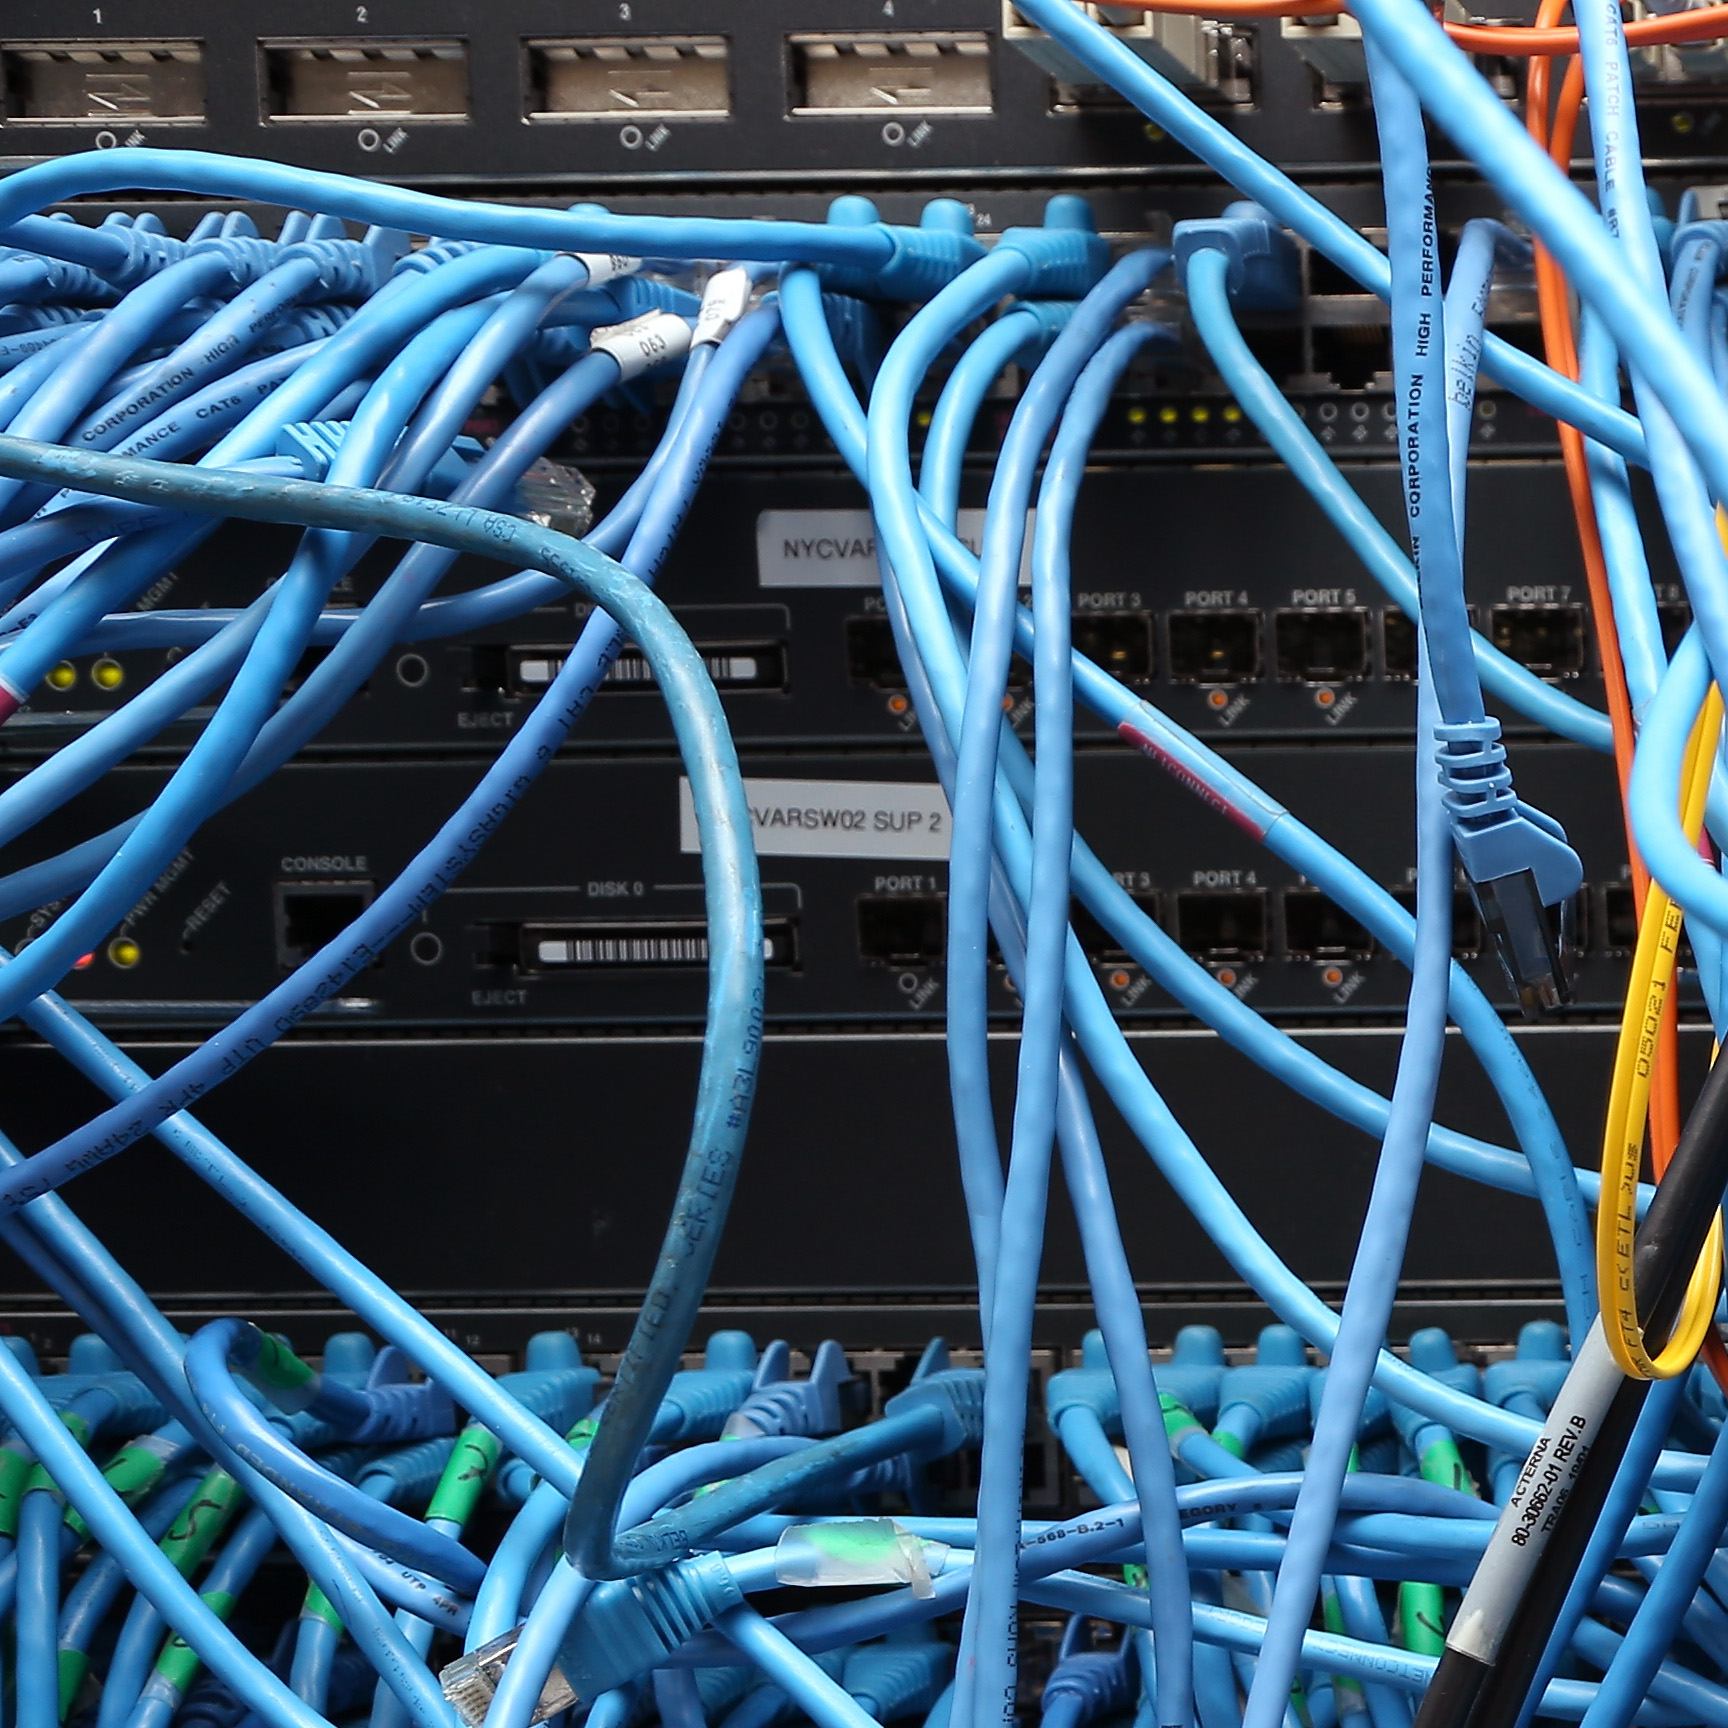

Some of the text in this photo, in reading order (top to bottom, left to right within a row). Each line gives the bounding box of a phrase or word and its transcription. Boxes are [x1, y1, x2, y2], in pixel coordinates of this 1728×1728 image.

[91, 9, 104, 26] 1
[355, 6, 368, 23] 2
[619, 4, 630, 21] 3
[881, 1, 894, 17] 4
[381, 129, 409, 155] LINK
[644, 124, 671, 152] LINK
[906, 120, 934, 148] LINK
[80, 366, 194, 445] CORPORATION
[203, 331, 241, 365] HIGH
[1409, 312, 1429, 519] CORPORATION HIGH
[783, 538, 878, 561] NYCVAR
[1079, 593, 1126, 609] PORT
[1184, 591, 1230, 607] PORT
[1292, 589, 1341, 605] PORT
[1219, 694, 1250, 726] LINK
[1324, 692, 1358, 725] LINK
[750, 807, 942, 834] VARSW02 SUP 2
[281, 855, 368, 873] CONSOLE
[588, 880, 643, 897] DISK 0
[874, 875, 935, 892] PORT 1
[1193, 870, 1239, 888] PORT
[909, 978, 940, 1011] LINK
[1335, 969, 1367, 1004] LINK
[1510, 1435, 1553, 1508] ACTERNA
[1511, 1414, 1587, 1549] 80-30662-01 REV.B
